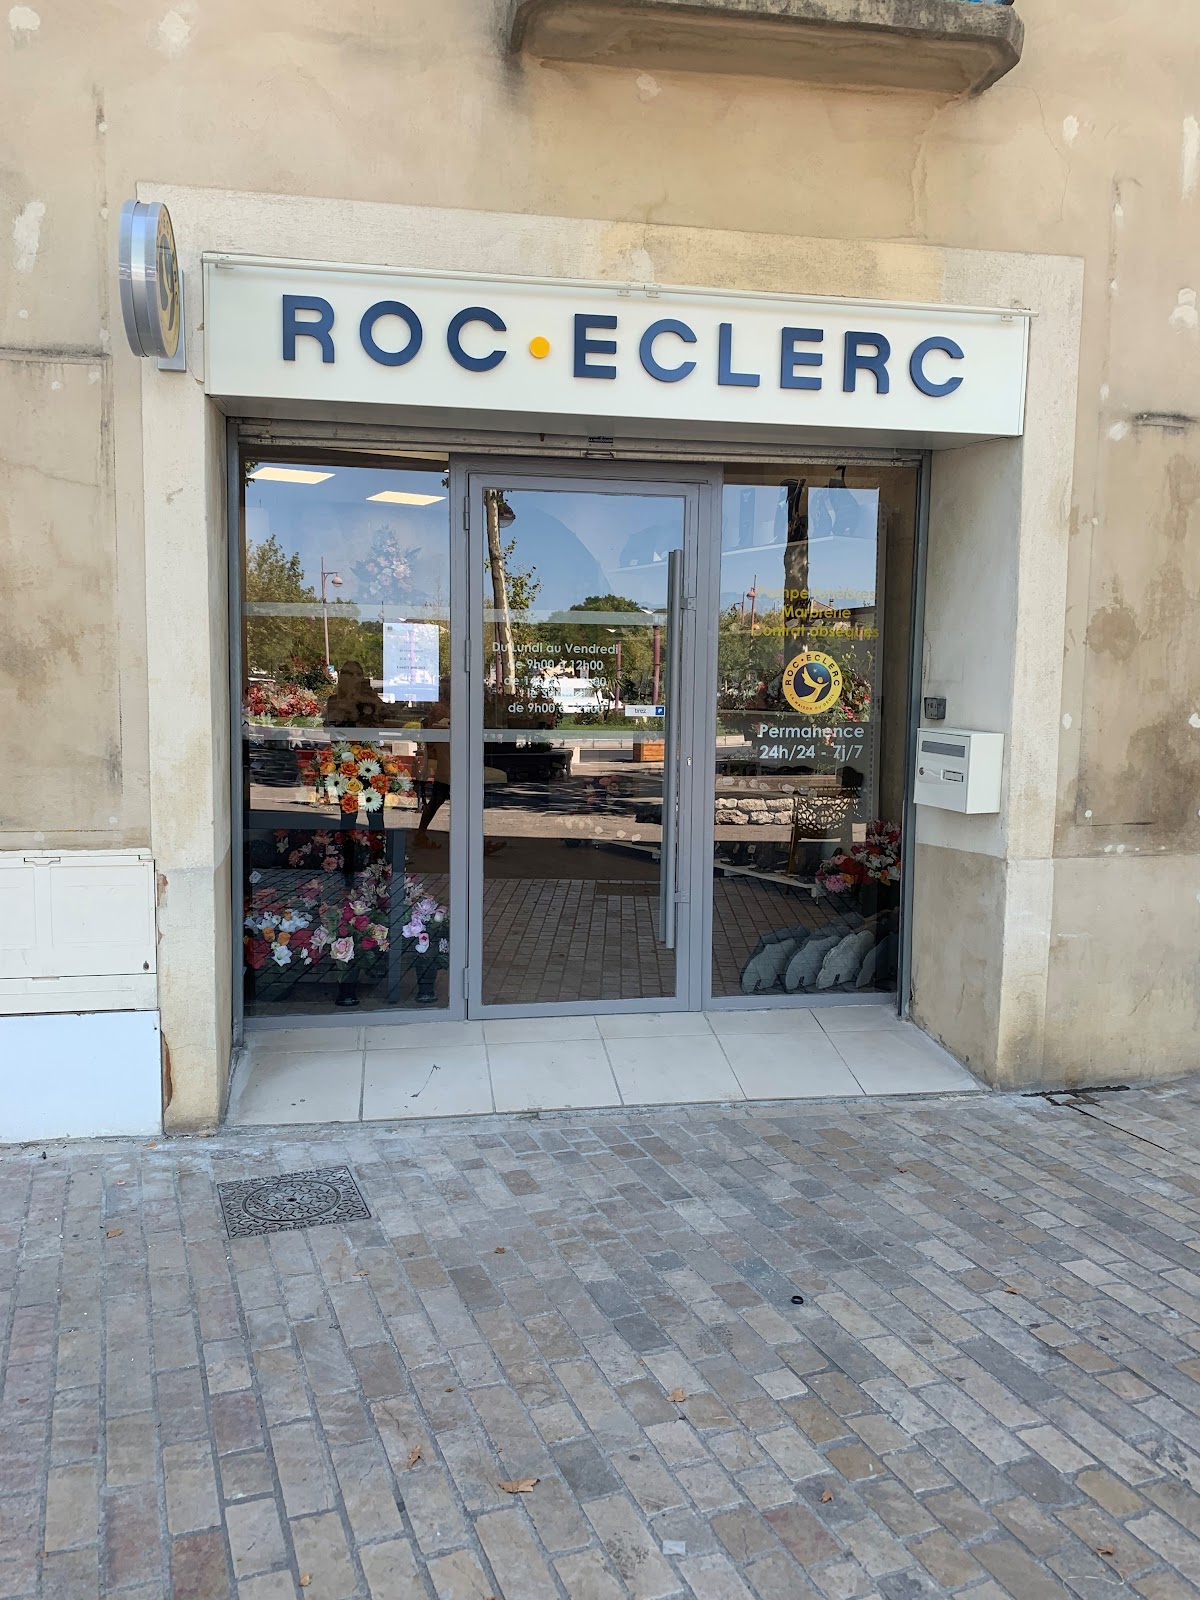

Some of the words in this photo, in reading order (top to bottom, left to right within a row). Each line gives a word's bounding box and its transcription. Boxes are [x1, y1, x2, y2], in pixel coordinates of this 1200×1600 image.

[282, 294, 507, 372] ROC
[573, 313, 964, 397] ECLERC
[782, 605, 852, 619] Marbrerie
[492, 641, 509, 652] Du
[511, 642, 543, 653] Lundi
[546, 644, 562, 653] au
[565, 643, 618, 655] Vendredi
[526, 659, 554, 669] 9h00
[570, 659, 604, 670] 12h00
[785, 661, 800, 686] ROC
[806, 654, 840, 686] ECLERC
[508, 703, 524, 713] de
[527, 703, 555, 713] 9h00
[759, 723, 865, 738] Permanence
[759, 744, 816, 762] 24h/24
[832, 744, 864, 762] 7j/7
